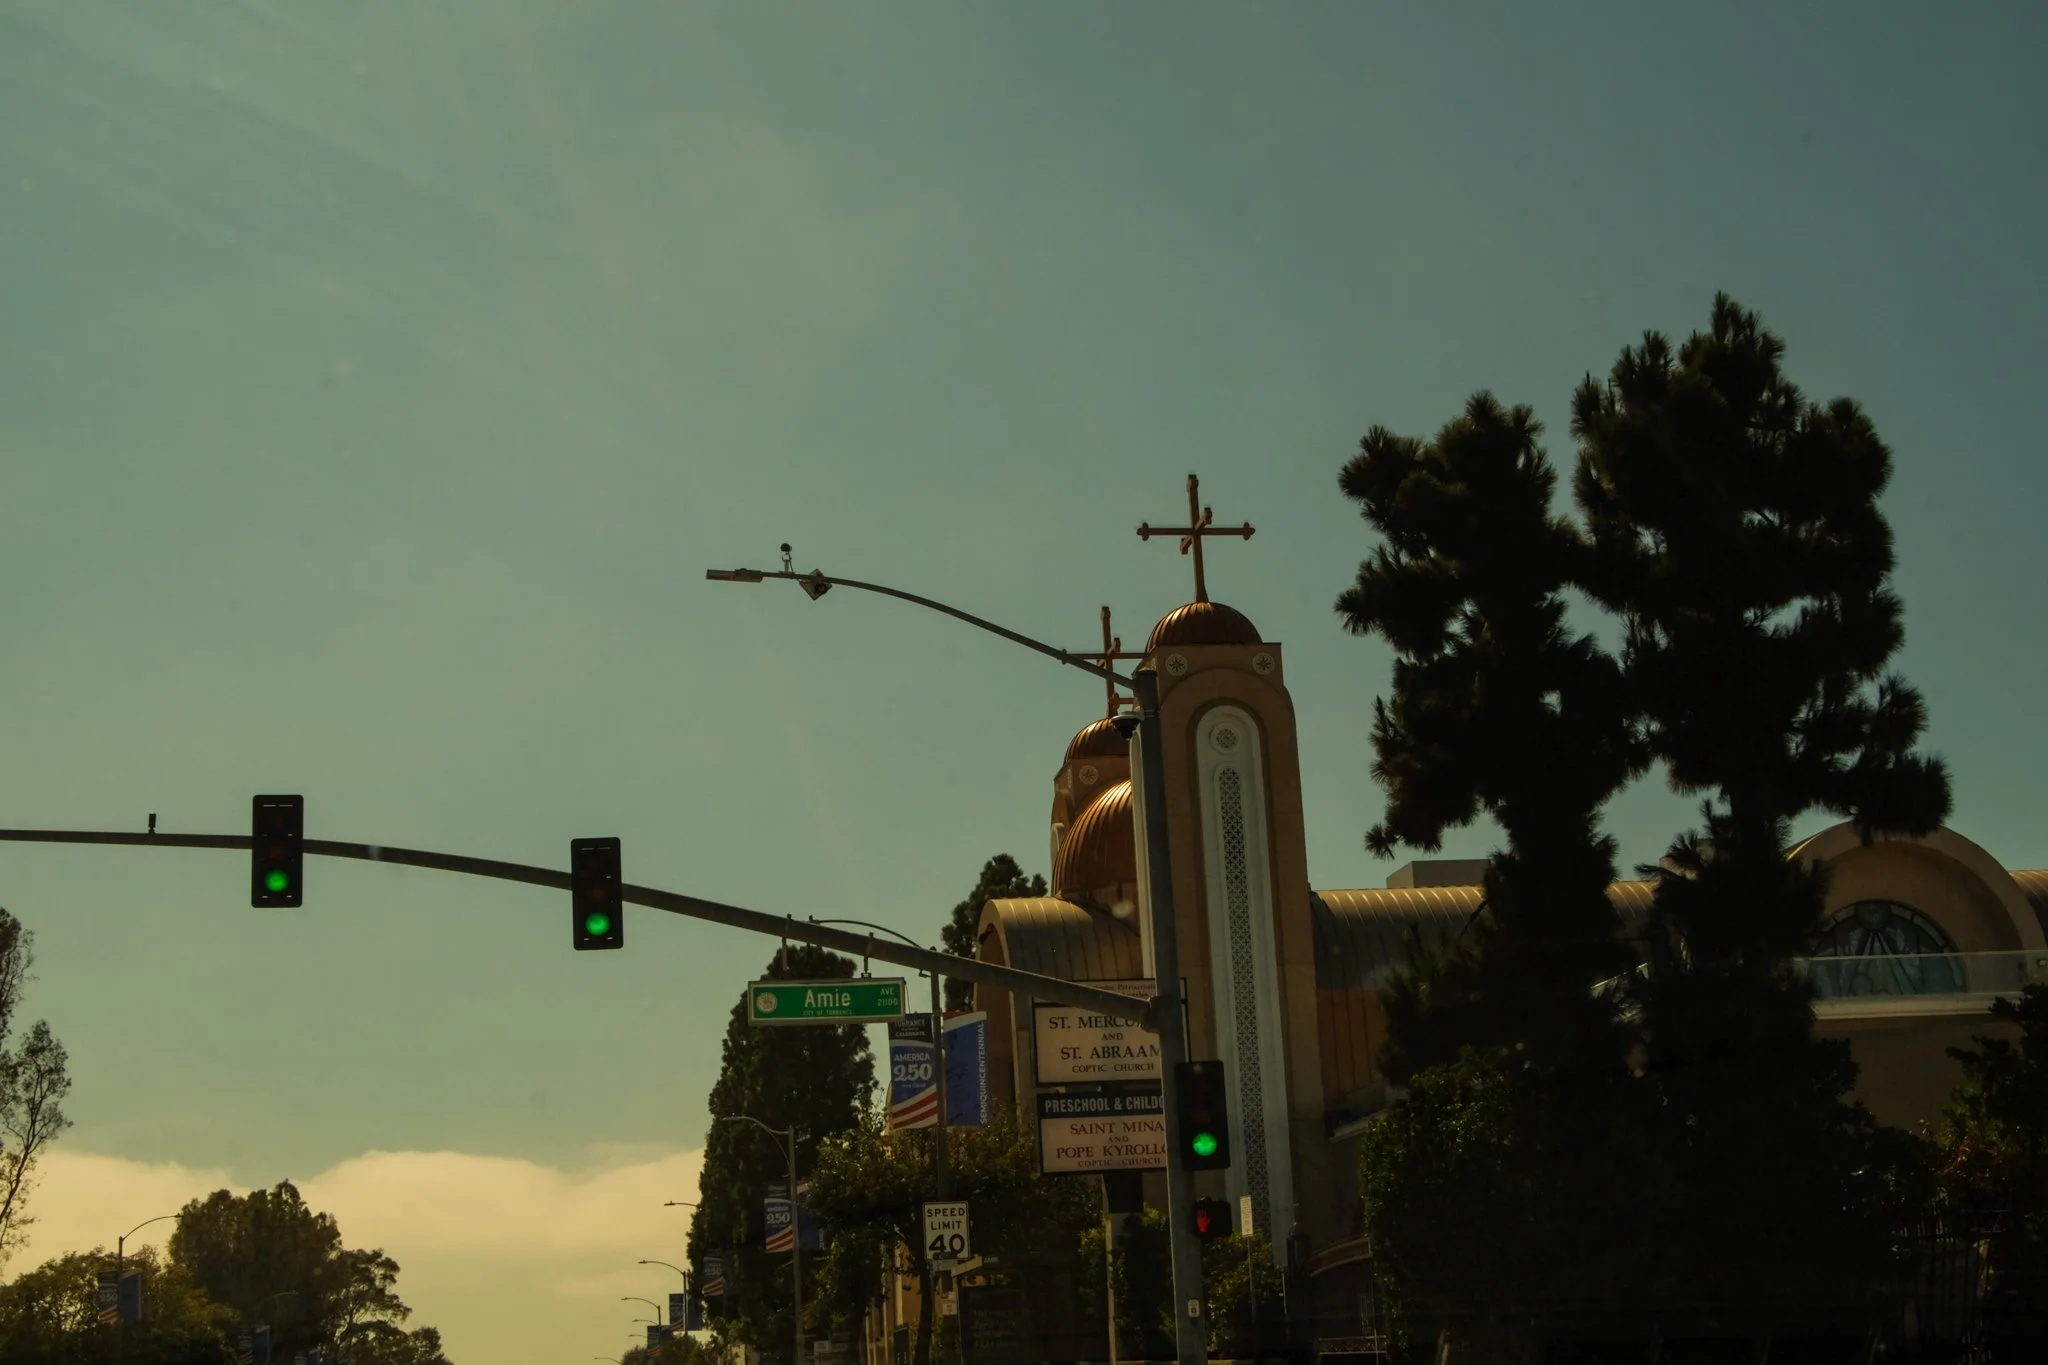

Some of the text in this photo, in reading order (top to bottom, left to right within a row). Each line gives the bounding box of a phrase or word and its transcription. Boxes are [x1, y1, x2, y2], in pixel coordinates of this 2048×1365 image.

[880, 987, 895, 996] AVE
[804, 988, 851, 1008] Amie
[877, 998, 899, 1007] 21100
[1049, 1016, 1071, 1029] ST.
[1101, 1033, 1124, 1041] AND
[894, 1052, 931, 1062] AMERICA
[1060, 1047, 1082, 1060] ST.
[893, 1063, 933, 1082] 250
[977, 1021, 988, 1125] SEMIQUINCENTENNIAL
[1072, 1062, 1154, 1073] COPTIC CHURCH
[1044, 1097, 1111, 1113] PRESCHOOL
[1114, 1096, 1122, 1111] &
[1070, 1120, 1164, 1135] SAINT MINA
[1108, 1135, 1129, 1143] AND
[1056, 1146, 1094, 1159] POPE
[1078, 1157, 1161, 1168] COPTIC CHURCH
[766, 1212, 790, 1224] 250
[926, 1207, 965, 1217] SPEED
[930, 1220, 962, 1230] LIMIT
[929, 1233, 965, 1254] 40
